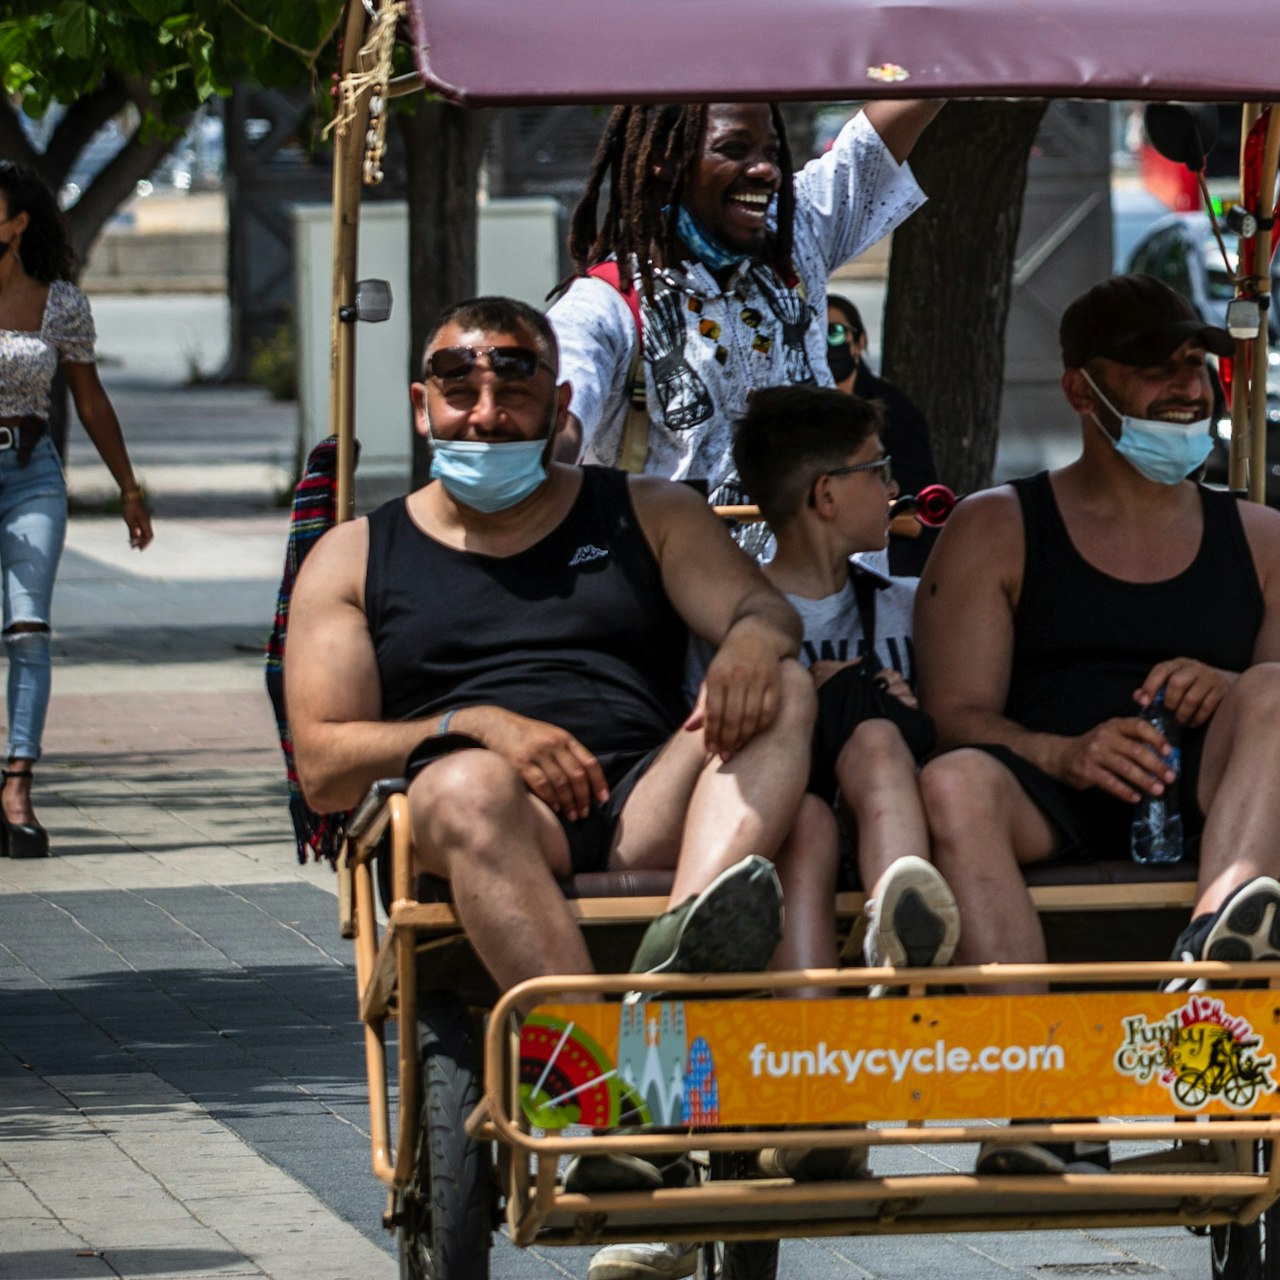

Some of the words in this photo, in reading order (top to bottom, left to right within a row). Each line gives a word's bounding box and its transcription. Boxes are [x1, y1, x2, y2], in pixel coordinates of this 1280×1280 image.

[1125, 1014, 1205, 1056] Funky
[748, 1039, 1065, 1084] funkycycle.com
[1117, 1044, 1183, 1080] Cycle
